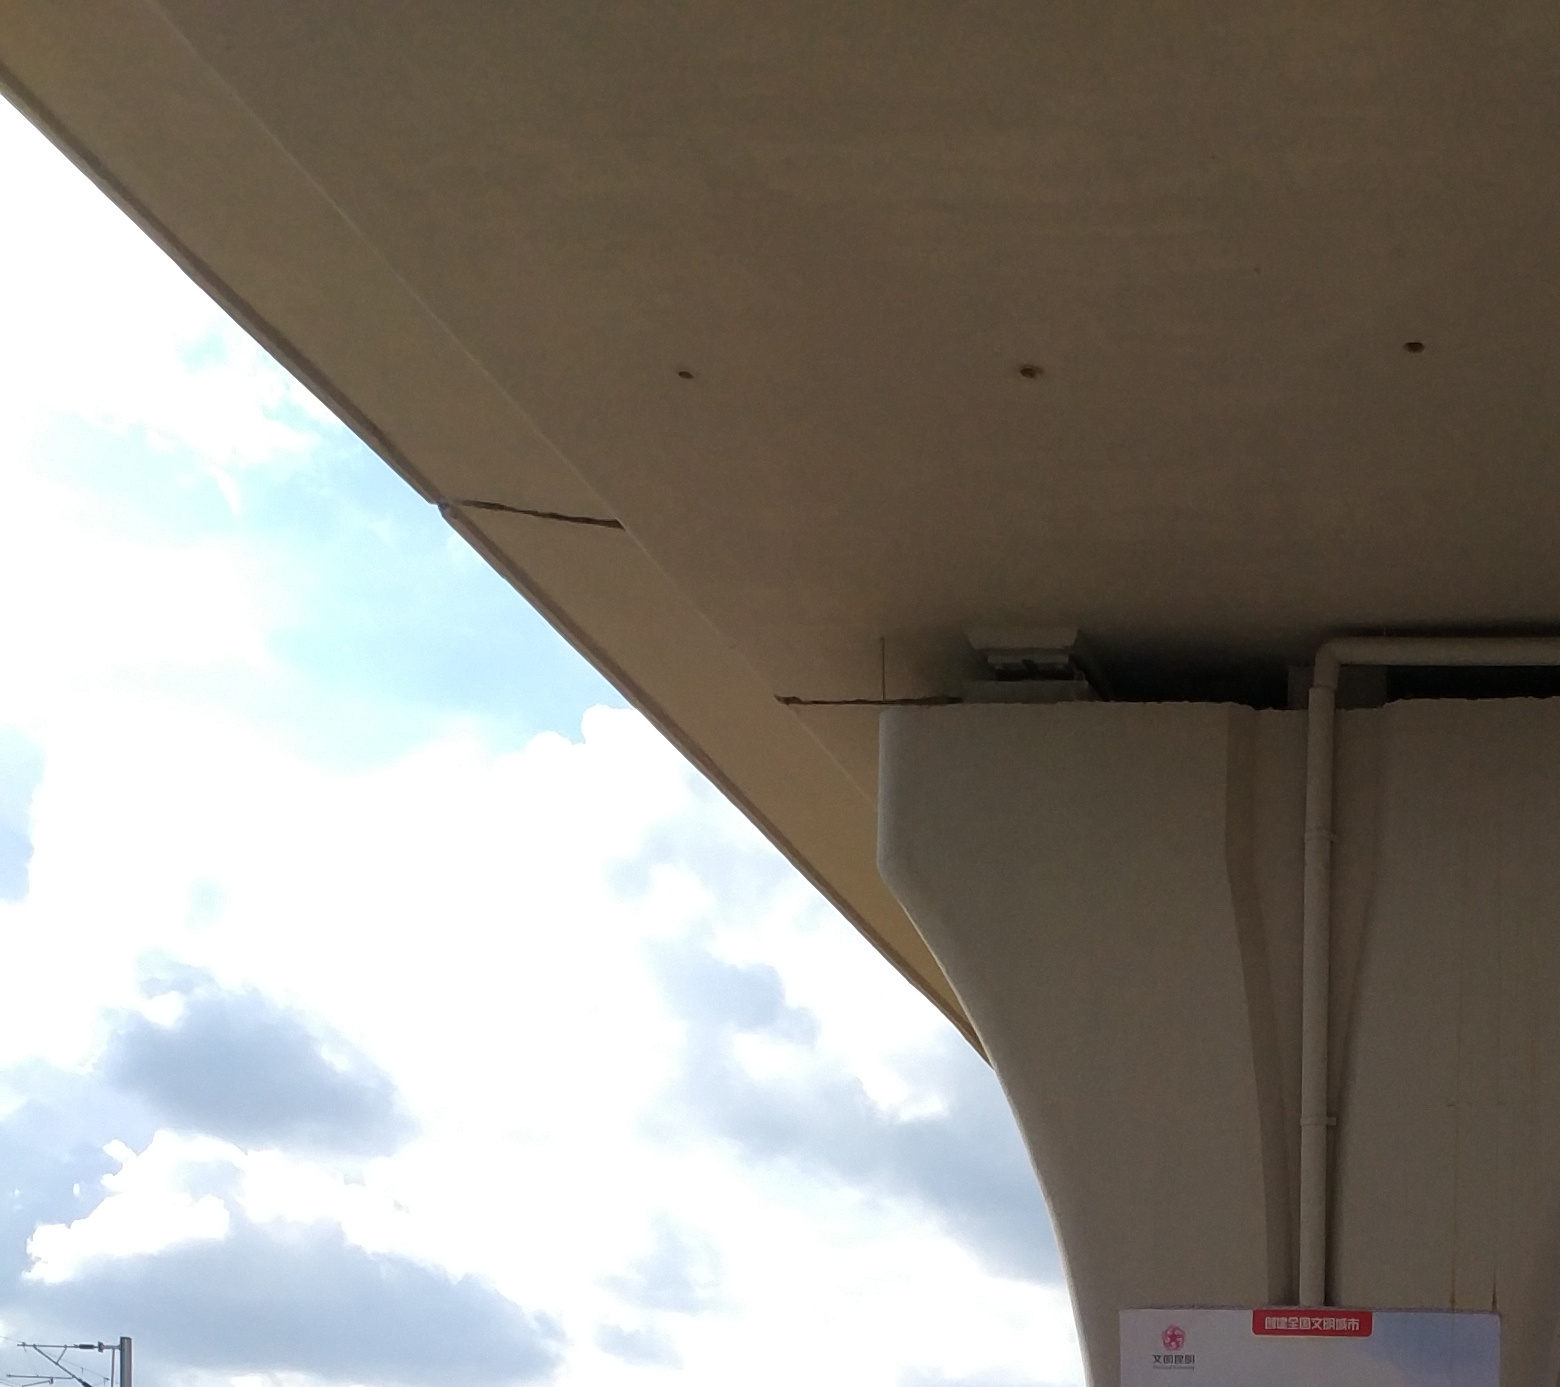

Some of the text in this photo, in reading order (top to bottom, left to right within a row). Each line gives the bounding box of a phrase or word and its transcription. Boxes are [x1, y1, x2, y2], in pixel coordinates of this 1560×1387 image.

[1265, 1316, 1360, 1331] 创建全国文明城市
[1152, 1354, 1195, 1365] 文明昆明
